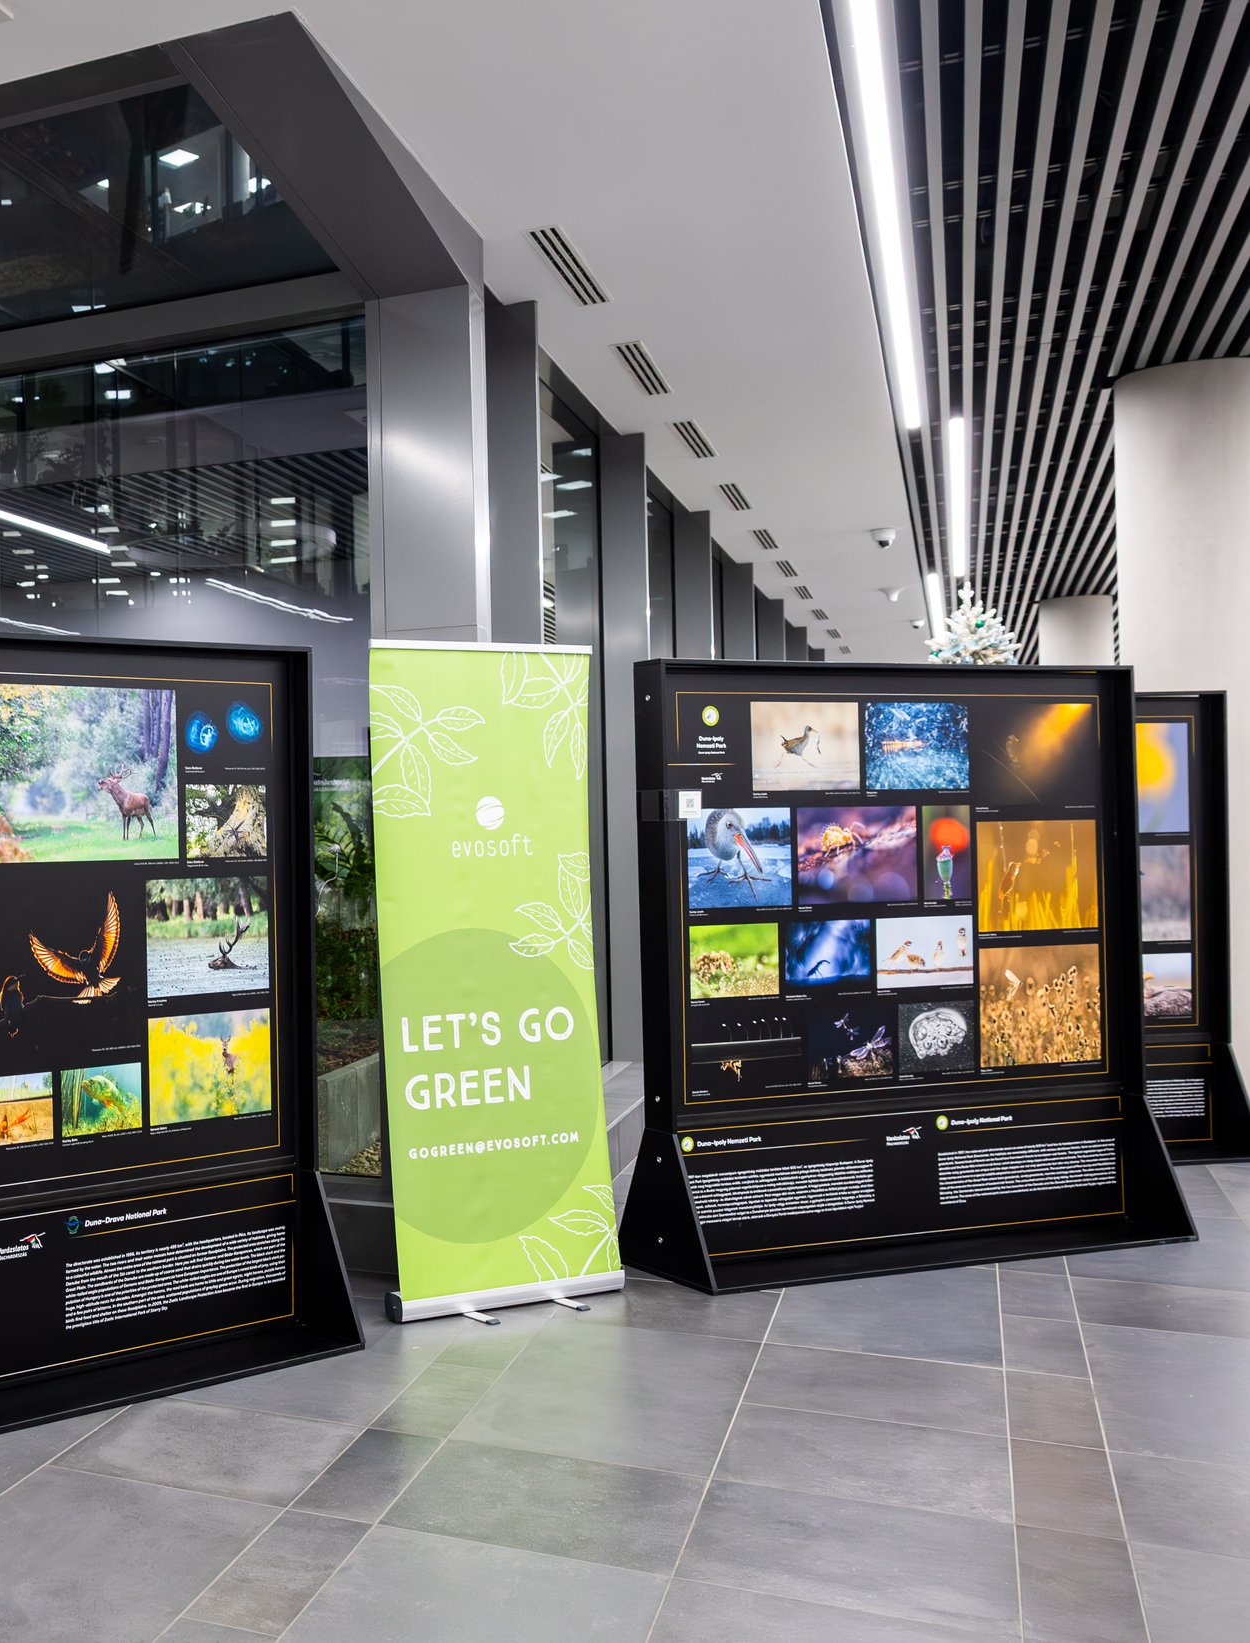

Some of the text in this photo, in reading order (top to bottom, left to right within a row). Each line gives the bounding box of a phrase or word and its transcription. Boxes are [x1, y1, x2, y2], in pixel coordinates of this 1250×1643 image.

[452, 834, 534, 858] evosoft
[518, 1006, 574, 1043] GO
[405, 1065, 532, 1112] GREEN
[408, 1131, 580, 1159] GOGREEN@EVOSOFT.COM
[727, 1137, 748, 1145] Nemzeti
[84, 1207, 167, 1227] Duna-Drava National Park
